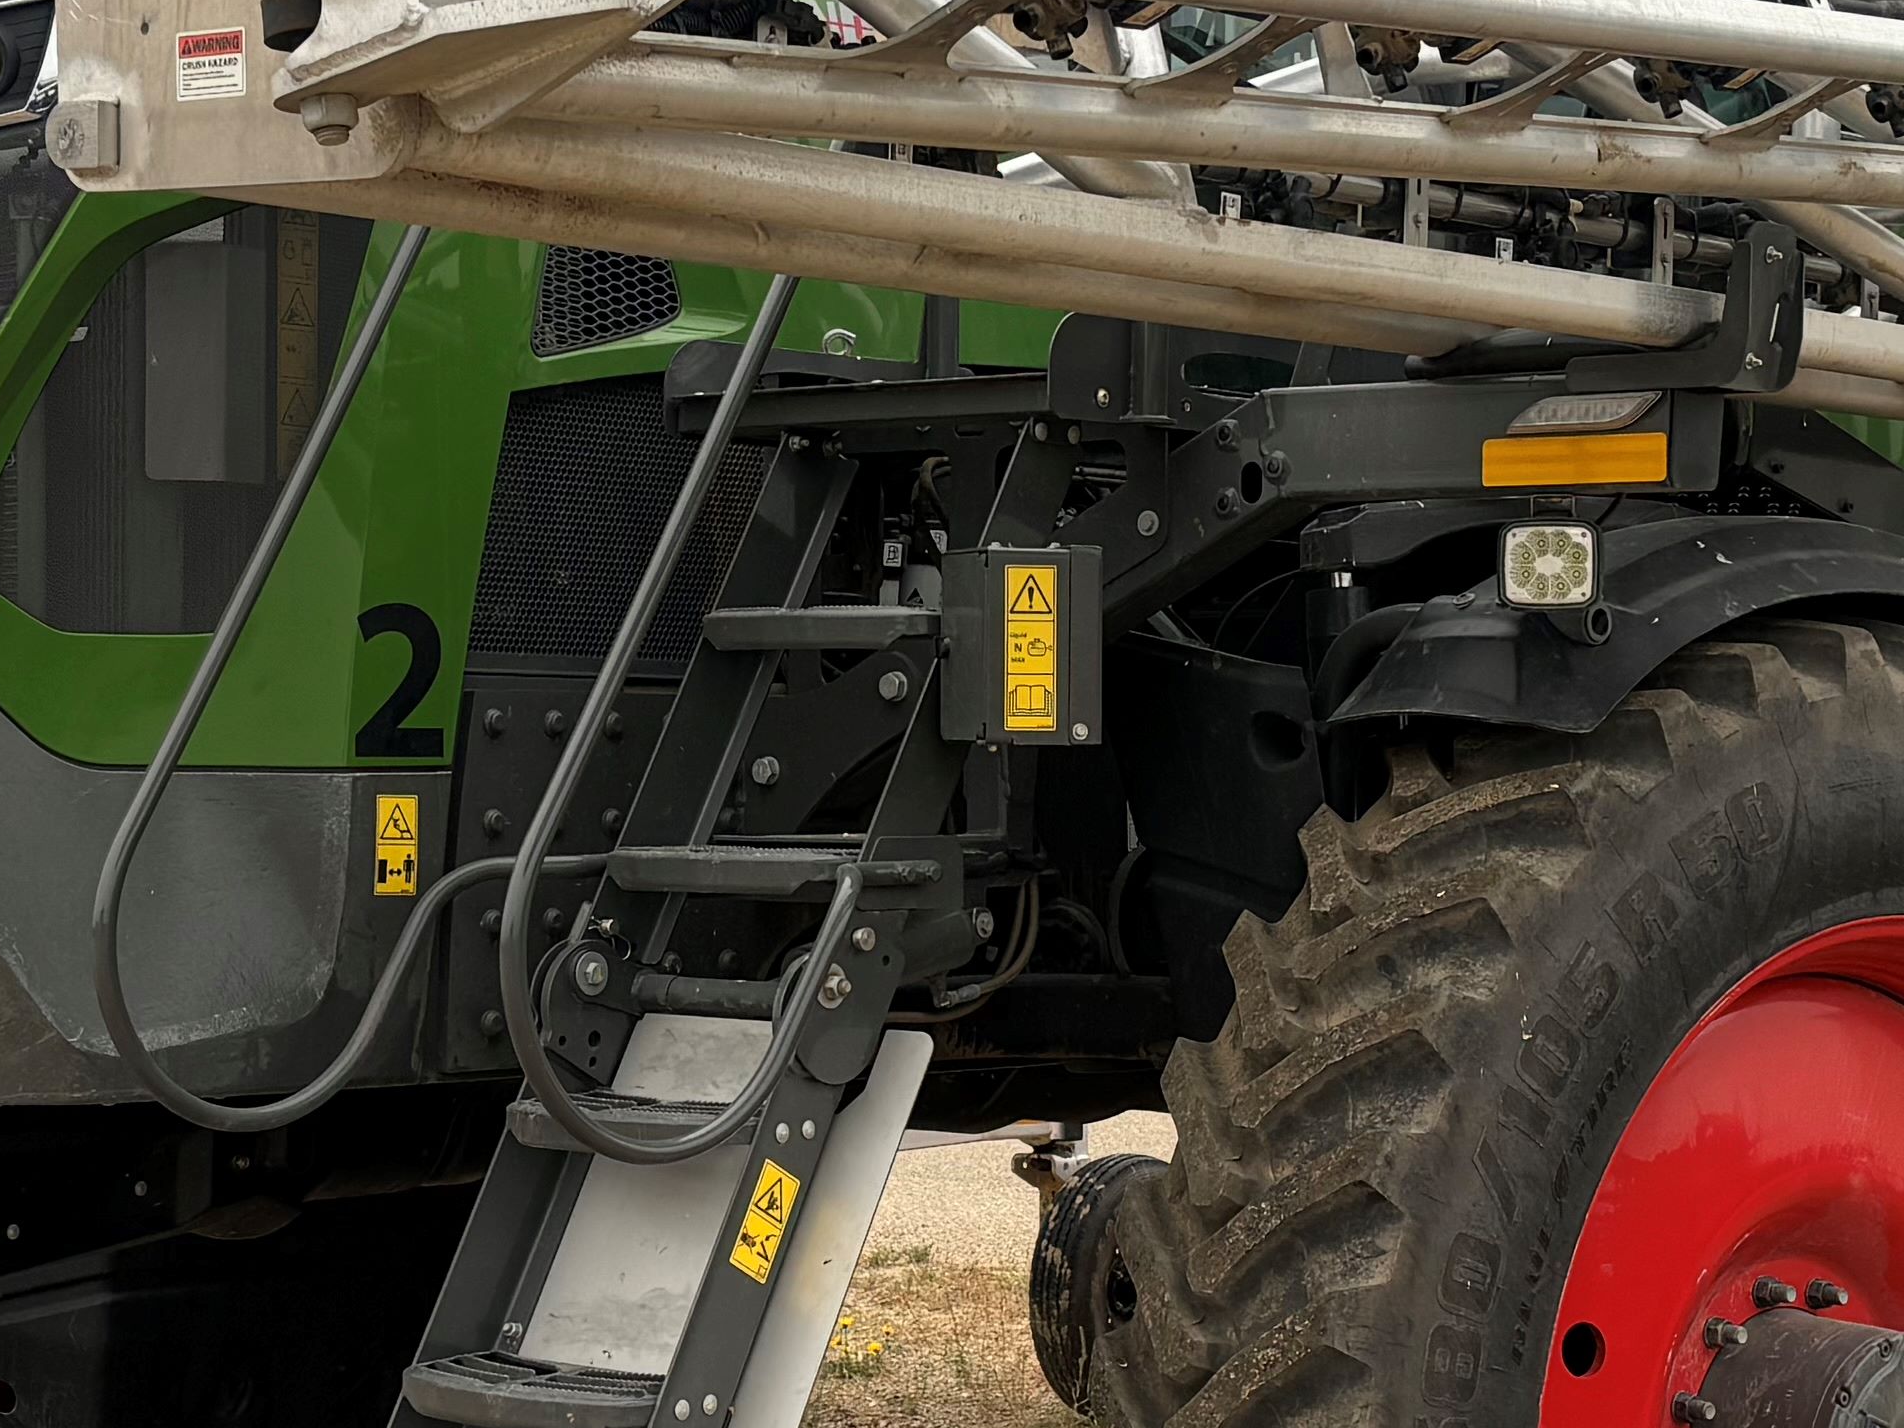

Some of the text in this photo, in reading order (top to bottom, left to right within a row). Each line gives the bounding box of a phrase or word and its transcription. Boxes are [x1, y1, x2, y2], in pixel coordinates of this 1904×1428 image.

[192, 35, 240, 53] WARNING
[182, 57, 238, 70] CRUSH HAZARD
[1014, 643, 1022, 652] N
[355, 602, 444, 759] 2
